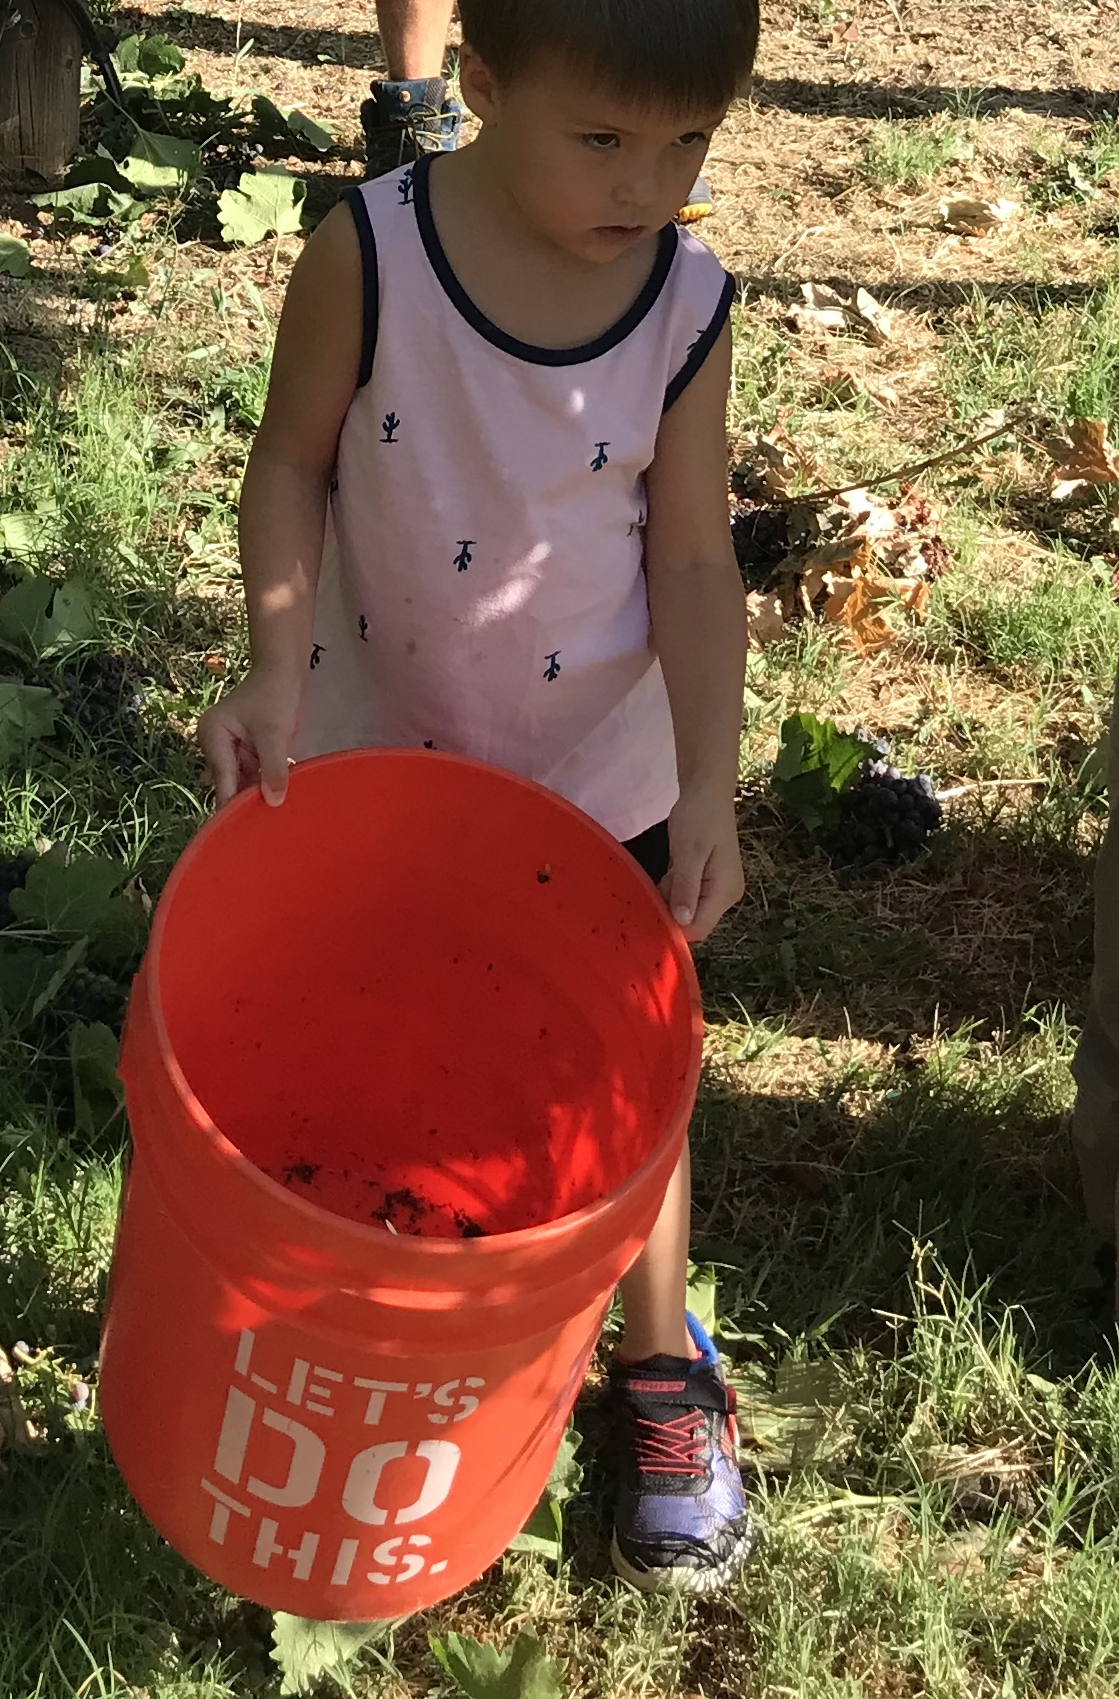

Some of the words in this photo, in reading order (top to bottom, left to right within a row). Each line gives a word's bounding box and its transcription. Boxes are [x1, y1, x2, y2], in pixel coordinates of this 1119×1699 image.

[234, 1328, 486, 1425] LET'S
[213, 1385, 462, 1526] DO
[200, 1477, 449, 1585] THIS.
